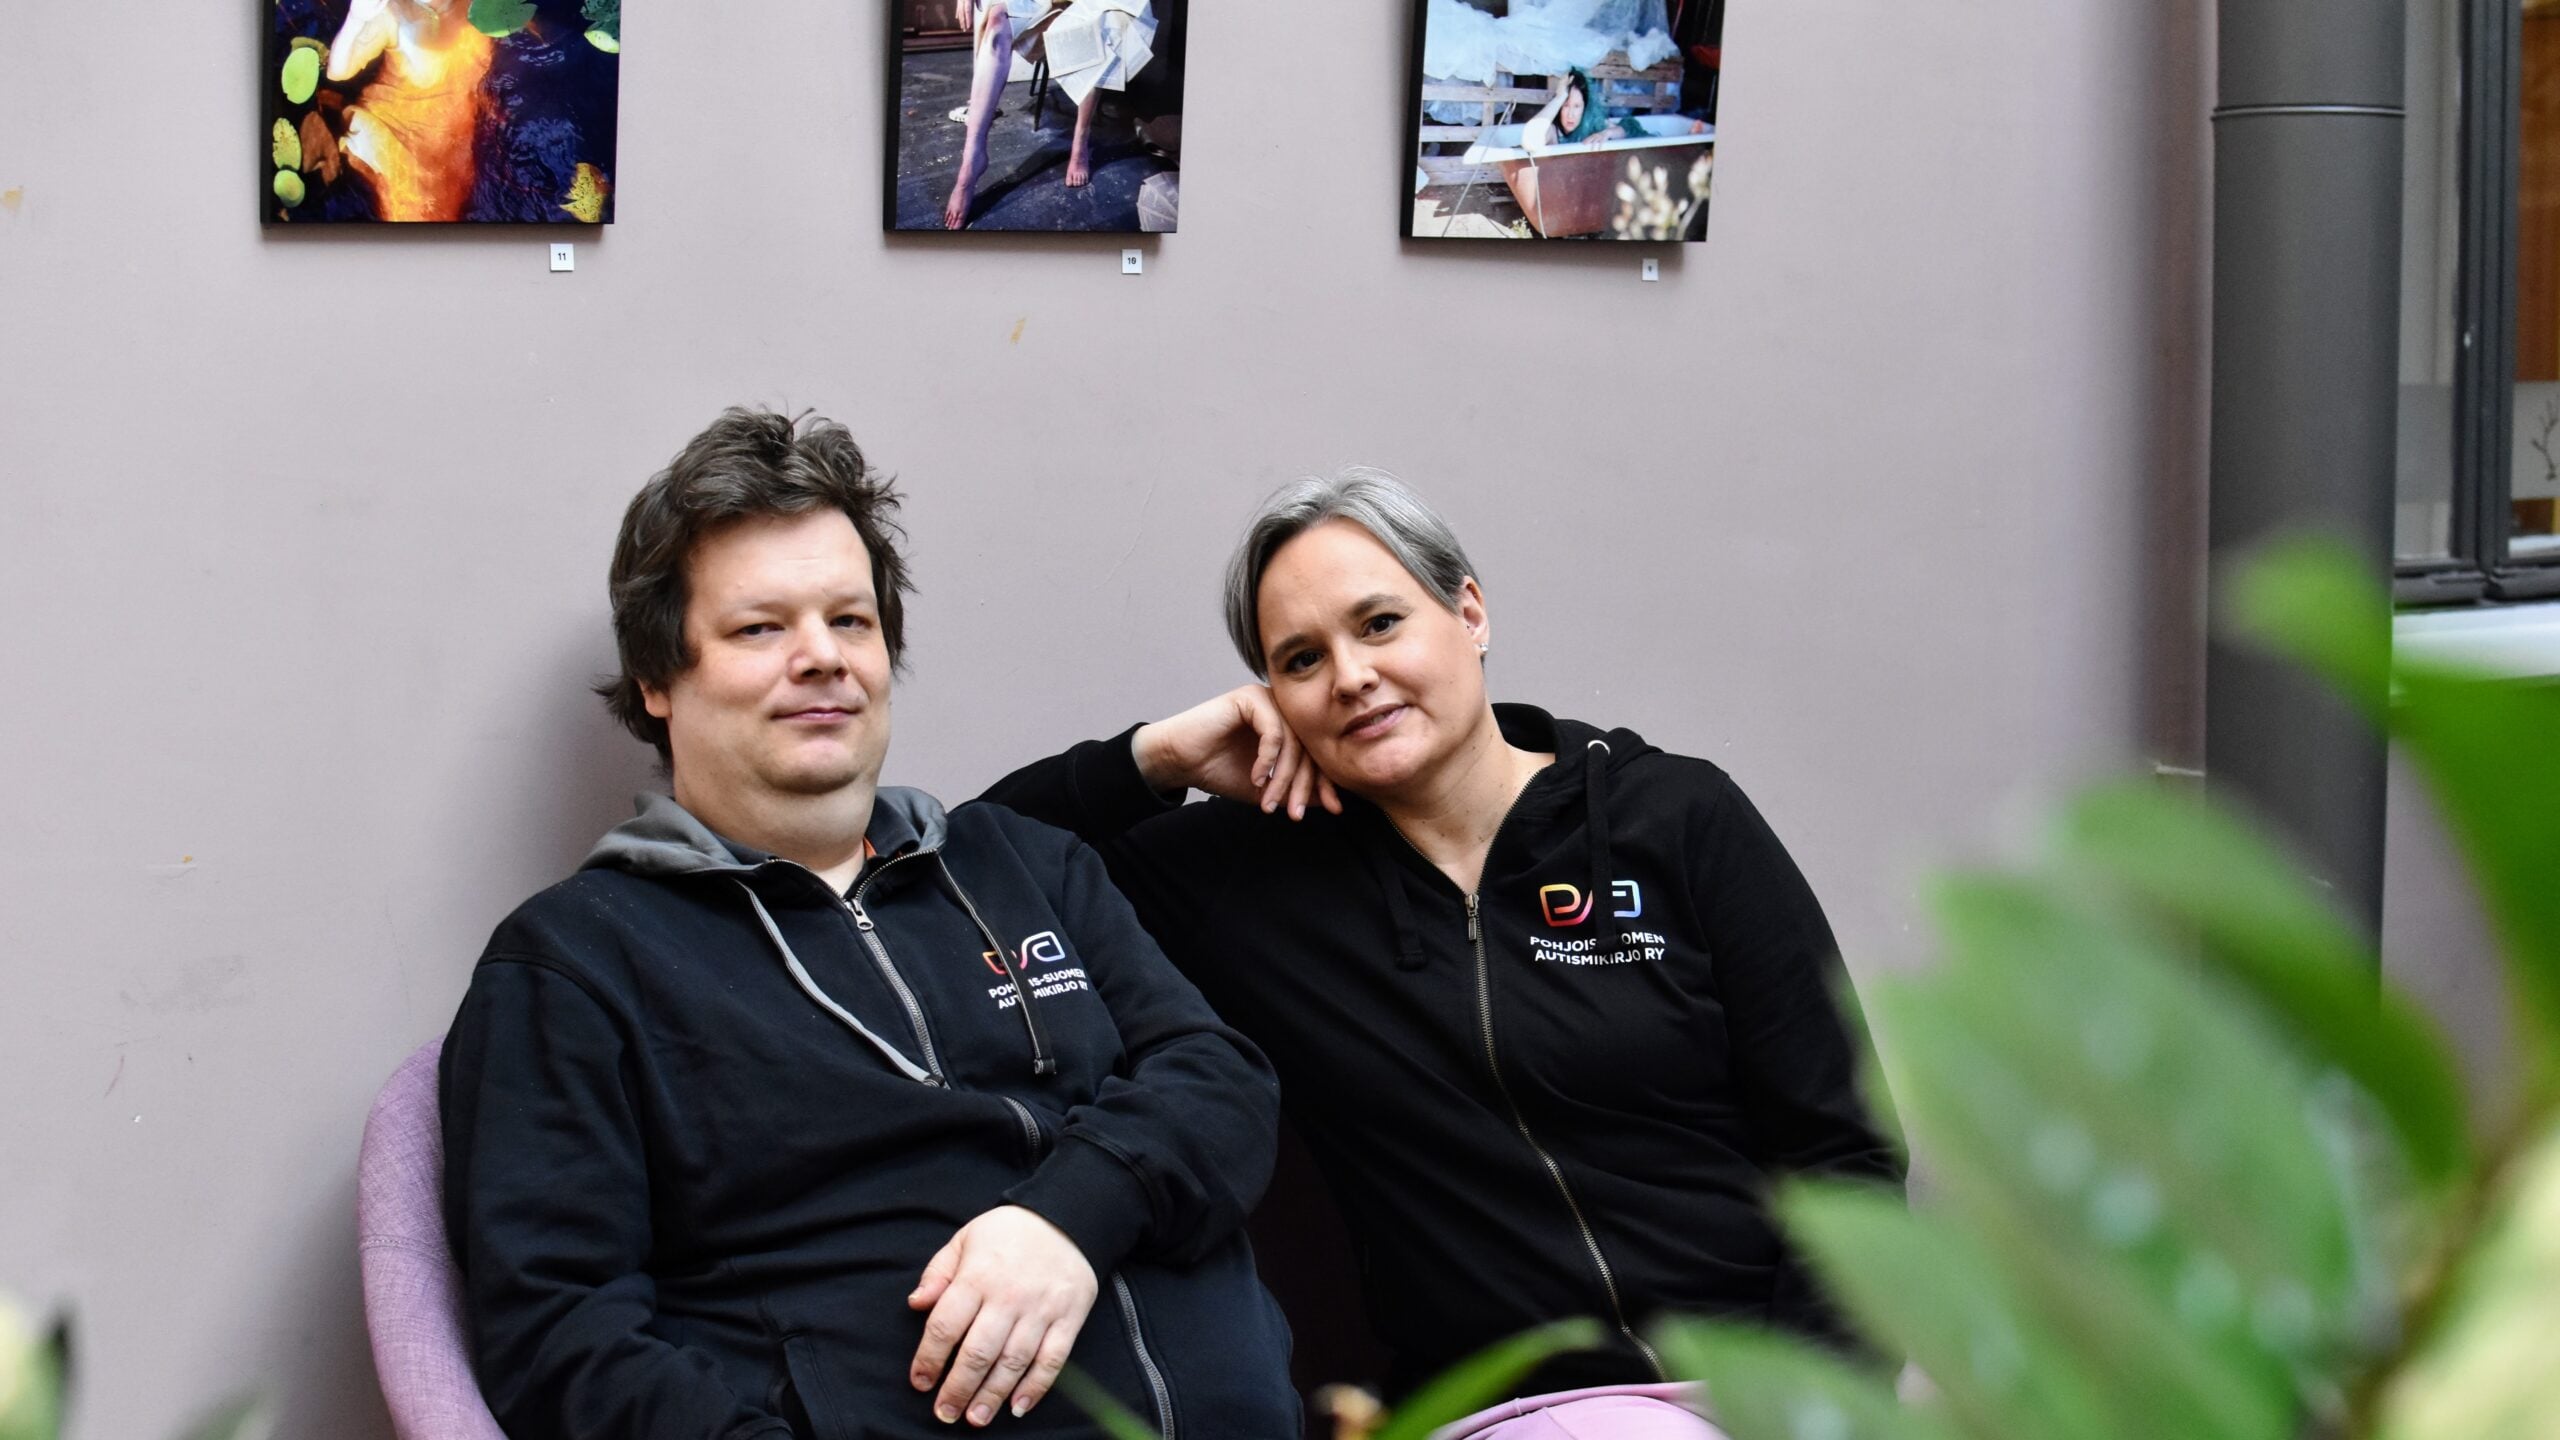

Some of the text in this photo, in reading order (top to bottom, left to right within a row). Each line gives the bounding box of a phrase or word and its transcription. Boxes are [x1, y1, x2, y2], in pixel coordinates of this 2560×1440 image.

[558, 252, 566, 261] 11
[1530, 931, 1666, 952] POHJOISOMEN
[1535, 947, 1665, 966] AUTISMIKIRJO RY
[988, 968, 1086, 998] POHIS-SUOMEN
[998, 980, 1078, 1009] AUTMIKIRJO
